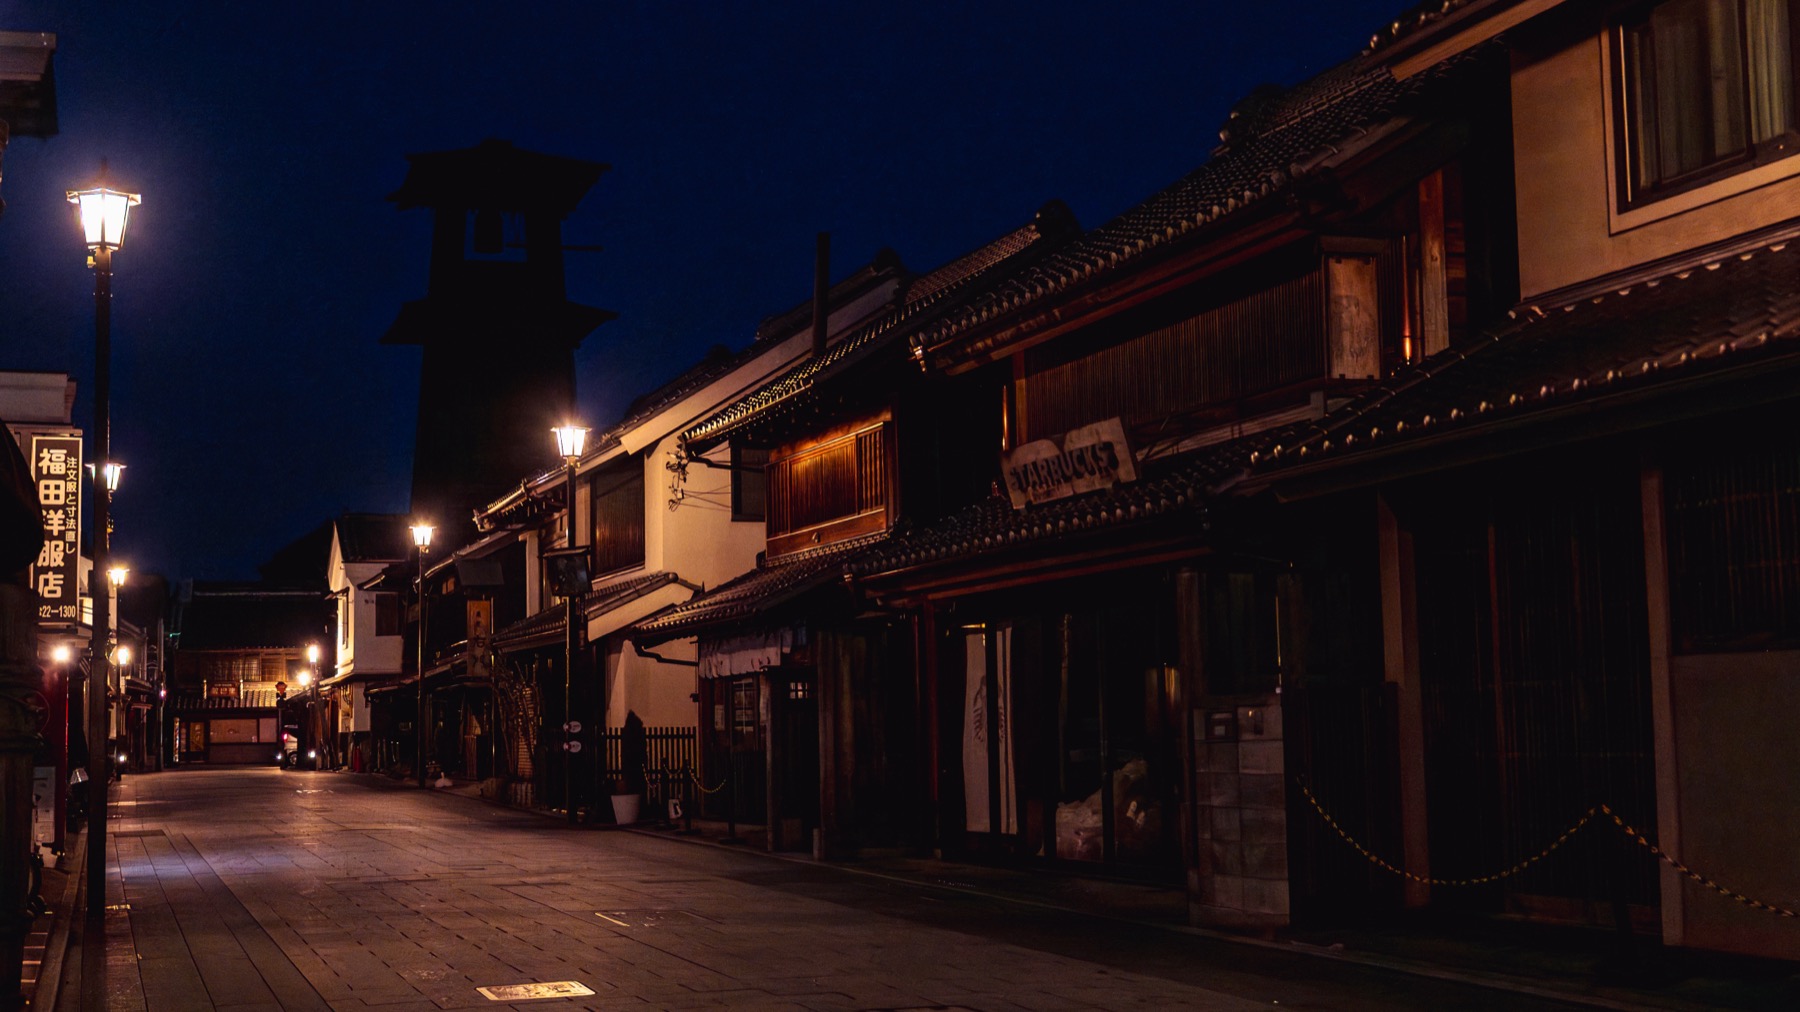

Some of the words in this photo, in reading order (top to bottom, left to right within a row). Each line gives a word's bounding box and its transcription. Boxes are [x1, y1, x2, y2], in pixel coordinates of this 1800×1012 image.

[66, 457, 77, 554] 注文服と寸法直し
[1010, 441, 1110, 491] STARBUCKS
[38, 448, 67, 598] 福田洋服店
